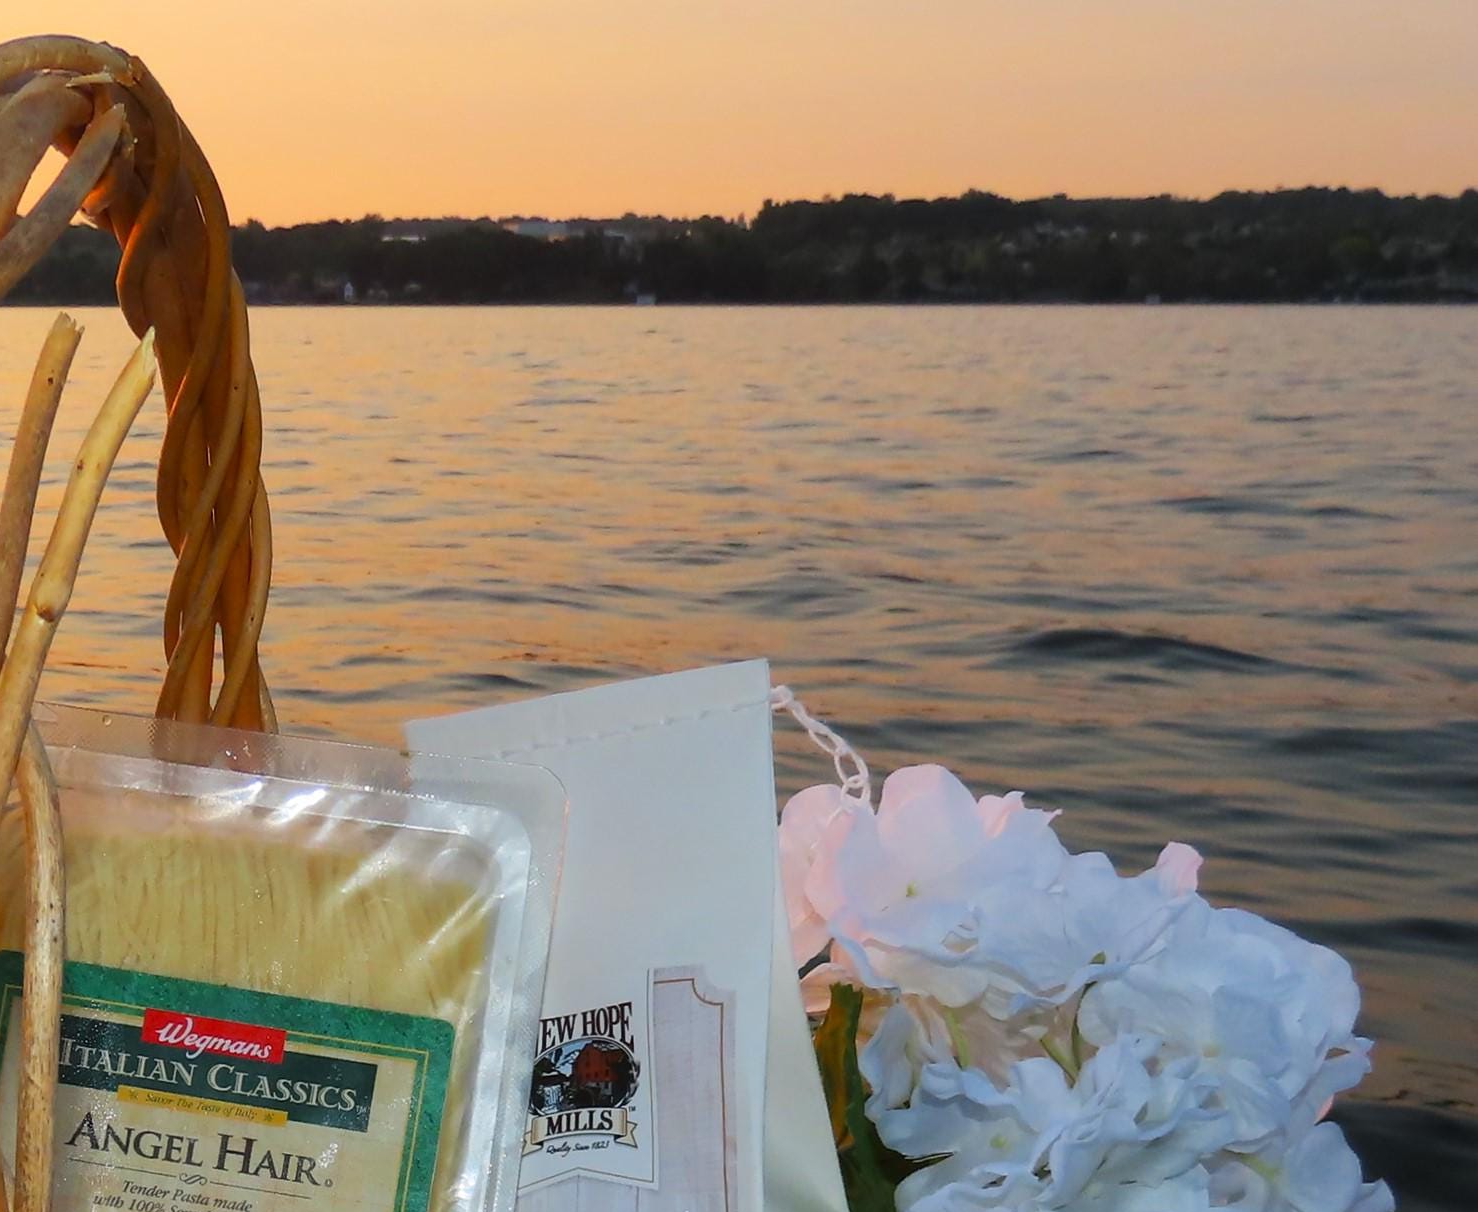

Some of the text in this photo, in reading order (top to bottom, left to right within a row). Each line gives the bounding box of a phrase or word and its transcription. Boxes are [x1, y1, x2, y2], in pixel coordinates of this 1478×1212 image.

[156, 1017, 272, 1059] Wegmans
[536, 1002, 634, 1056] EW HOPE
[59, 1037, 198, 1086] ITALIAN
[207, 1063, 357, 1112] CLASSICS
[547, 1110, 613, 1136] MILLS
[65, 1112, 319, 1187] ANGEL HAIR
[93, 1194, 124, 1209] with
[122, 1180, 253, 1212] Tender Pasta made
